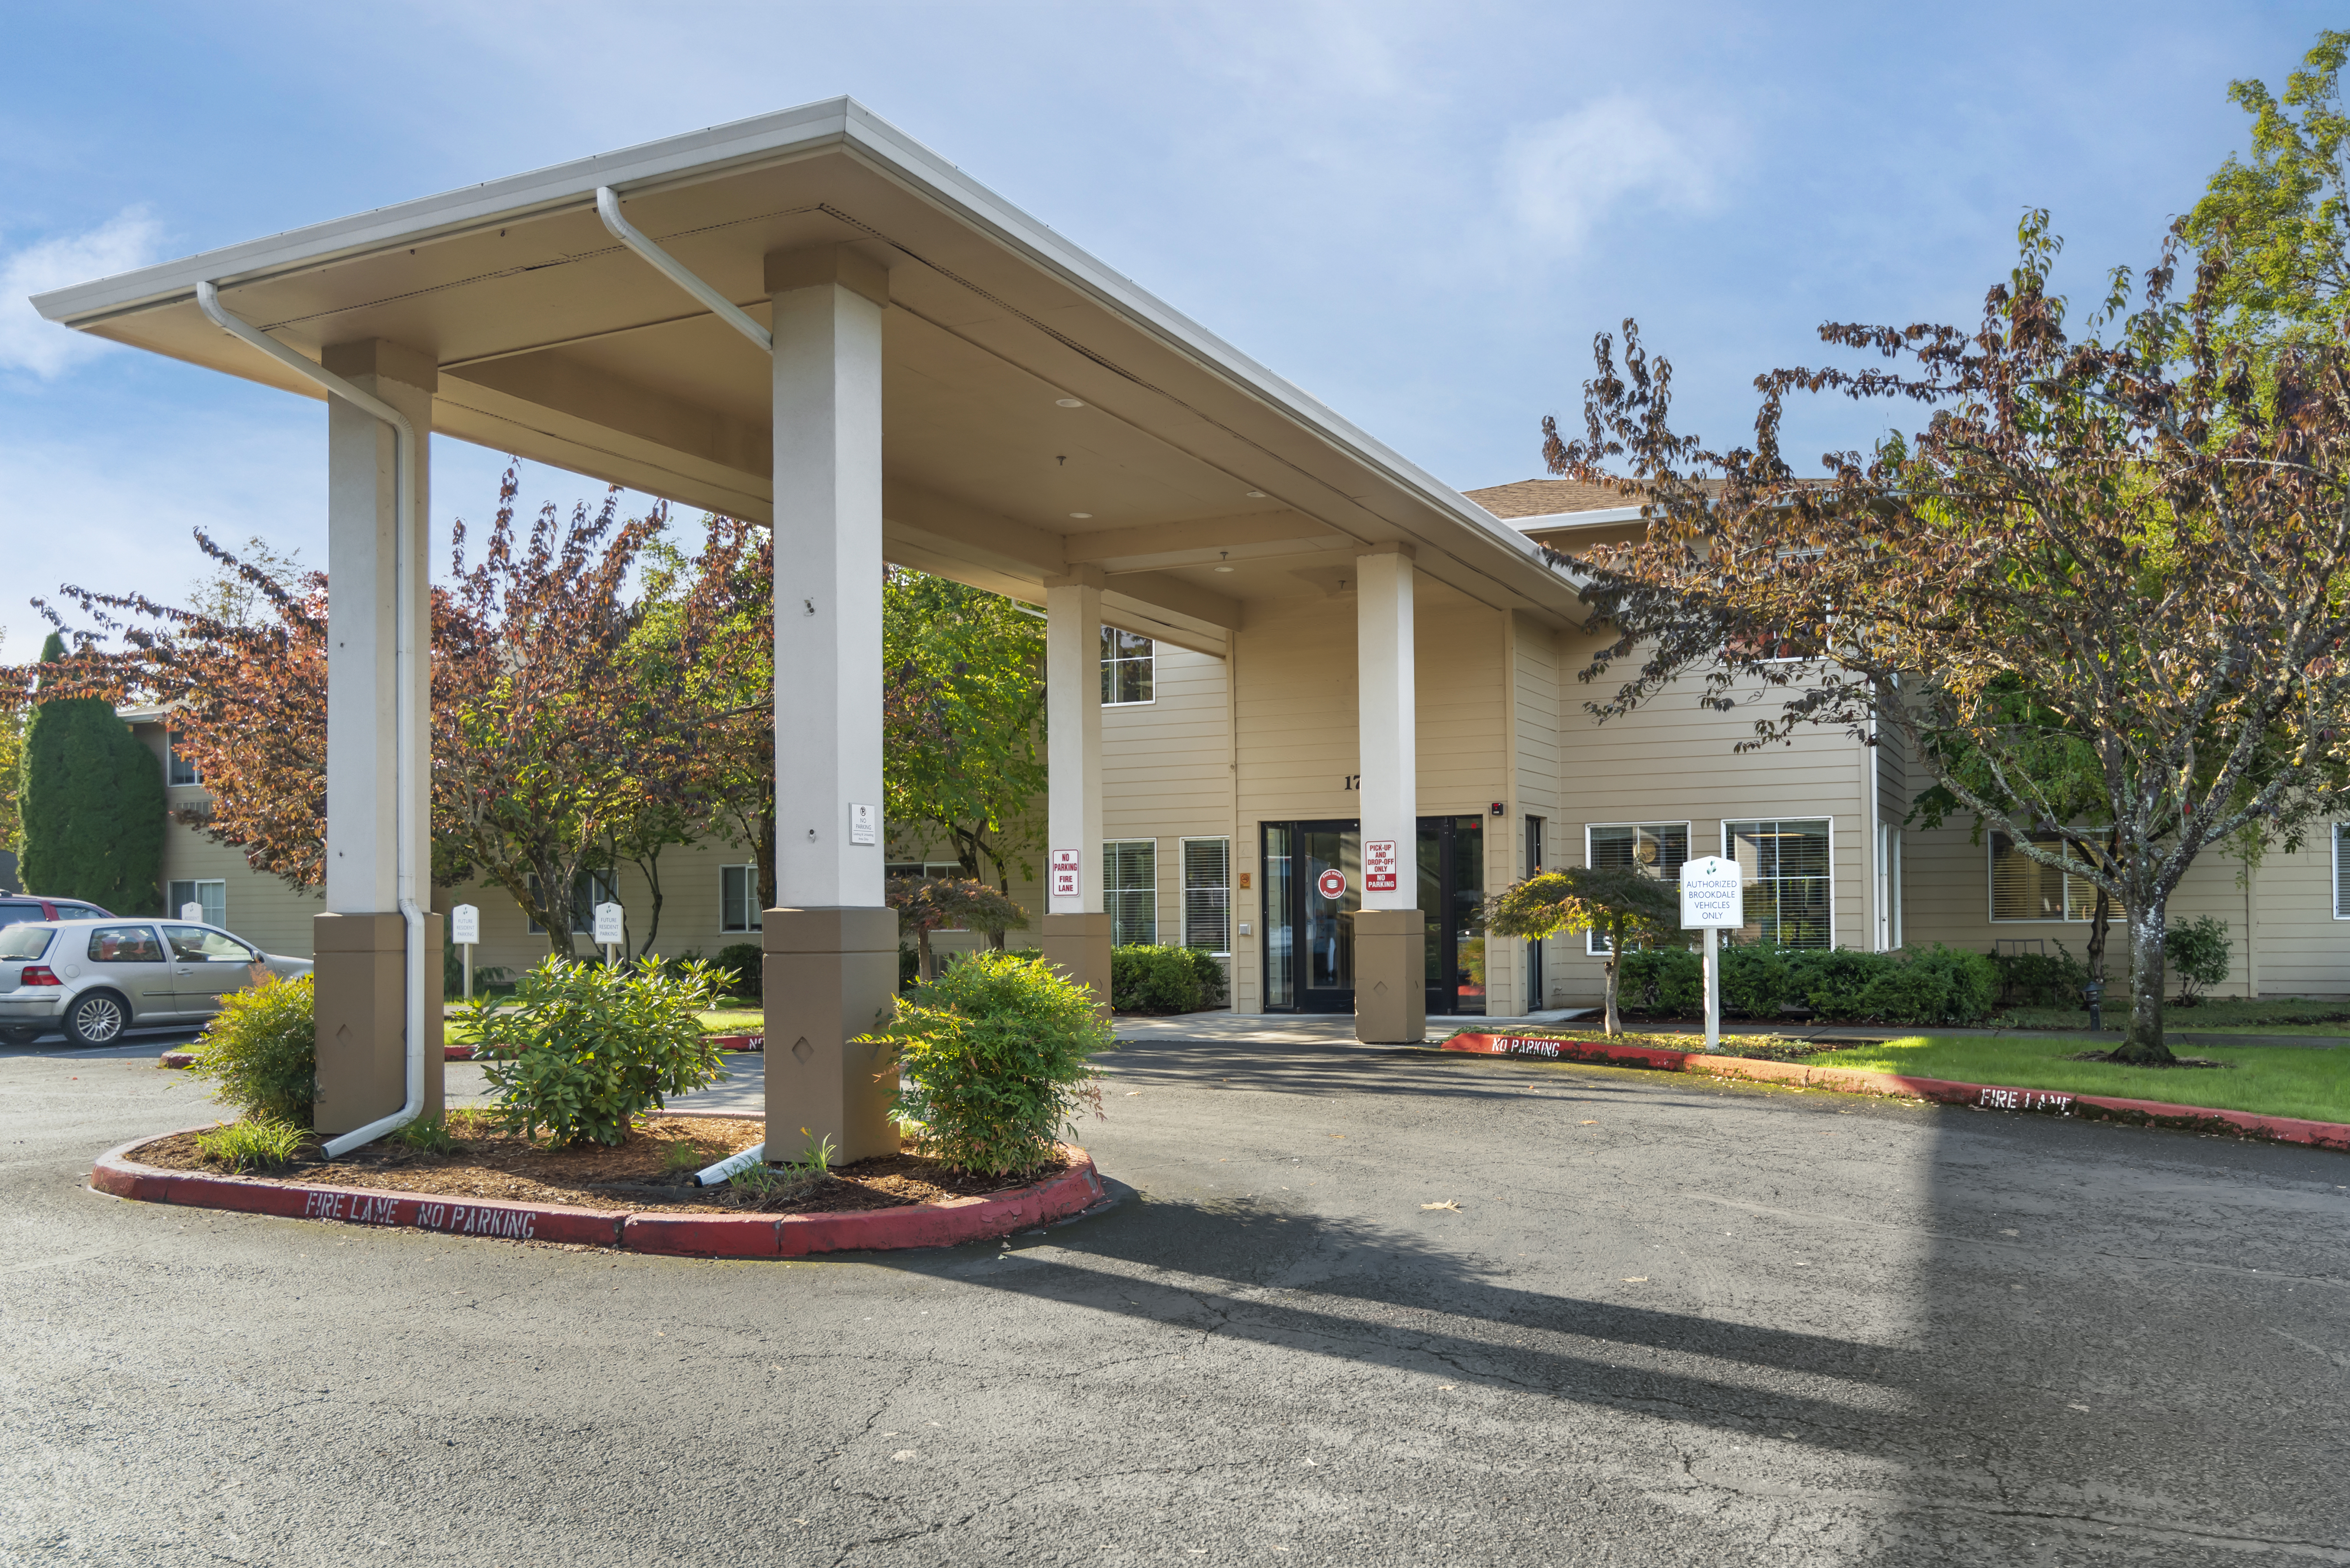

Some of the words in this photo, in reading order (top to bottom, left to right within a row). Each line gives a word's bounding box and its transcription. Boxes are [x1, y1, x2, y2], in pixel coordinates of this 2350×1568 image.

[1345, 775, 1360, 790] 17
[1062, 853, 1070, 861] NO
[1054, 863, 1077, 871] PARKING
[1492, 1037, 1508, 1052] NO
[1511, 1039, 1560, 1057] PARKING
[1980, 1088, 2018, 1109] FIRE
[306, 1192, 345, 1218] FIRE
[350, 1195, 400, 1225] LANE
[417, 1202, 446, 1228] NO
[450, 1206, 536, 1239] PARKING
